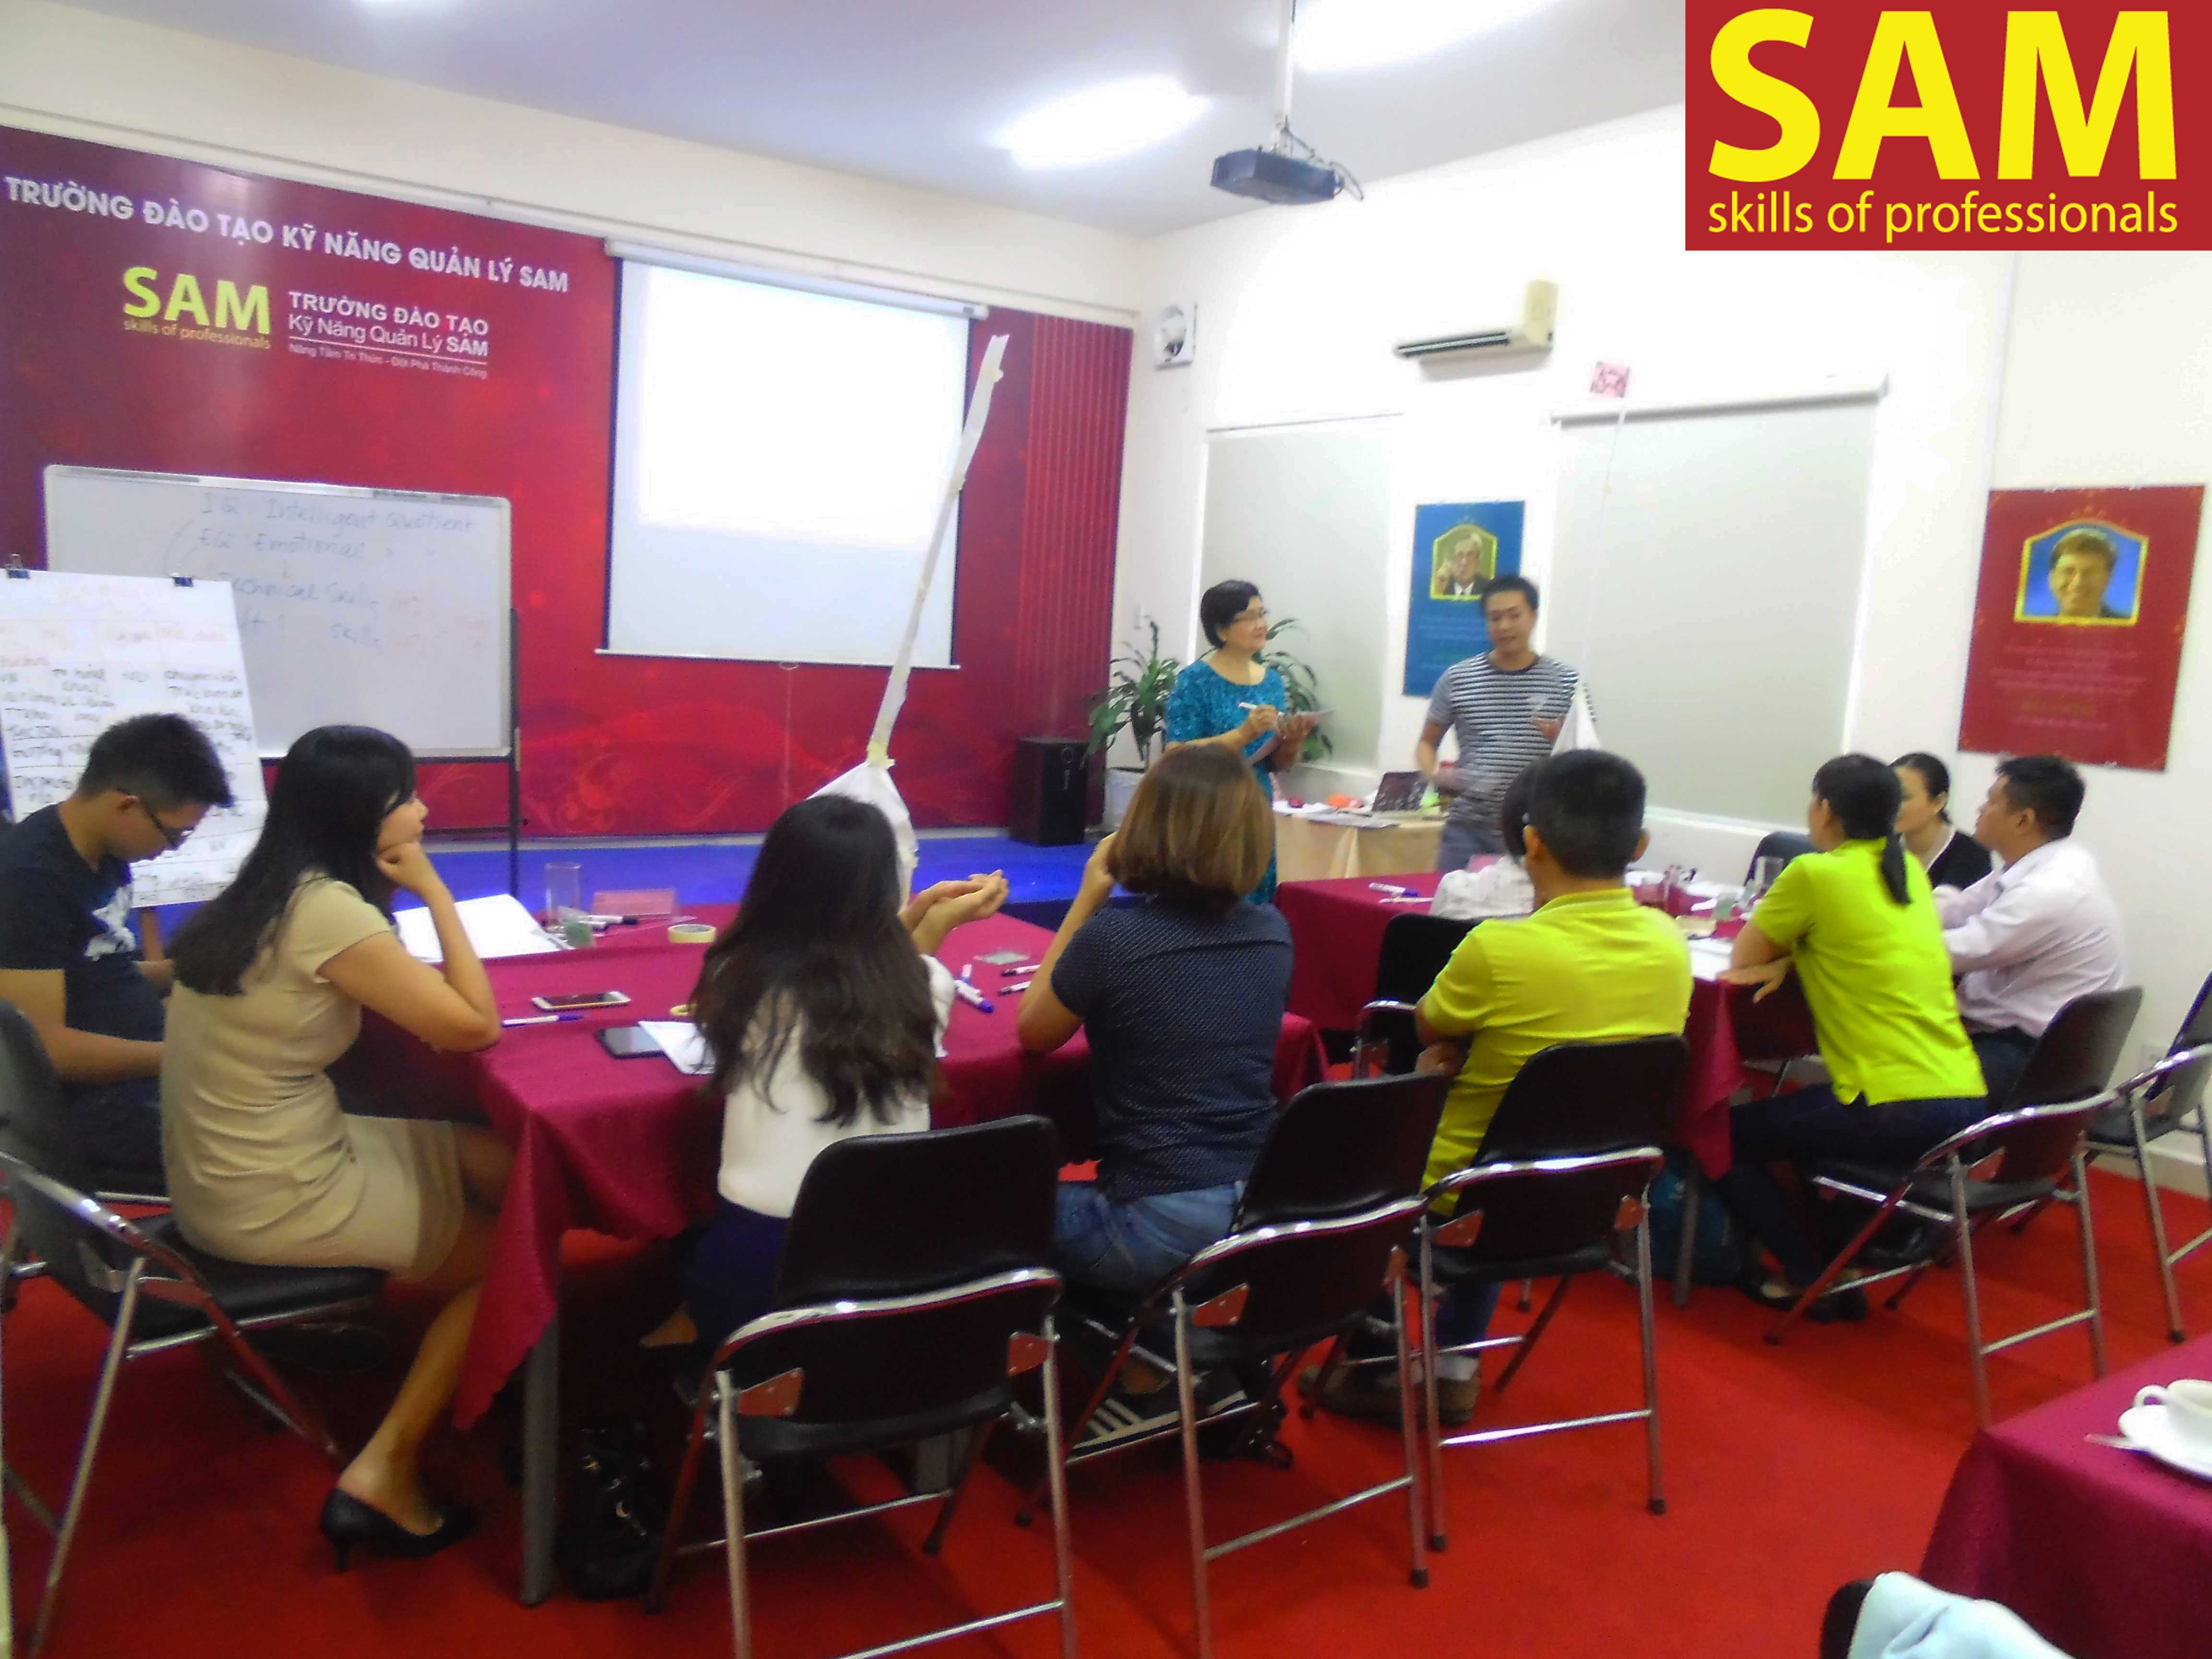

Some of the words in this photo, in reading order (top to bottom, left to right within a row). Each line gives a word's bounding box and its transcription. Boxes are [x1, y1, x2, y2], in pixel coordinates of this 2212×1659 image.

[4, 176, 135, 220] TRƯỜNG
[143, 198, 209, 232] ĐÀO
[217, 214, 273, 245] TẠO
[282, 223, 317, 251] KỸ
[324, 230, 402, 264] NĂNG
[409, 246, 480, 278] QUẢN
[488, 257, 512, 283] LÝ
[519, 265, 568, 292] SAM
[123, 266, 271, 334] SAM
[289, 291, 387, 321] TRƯỜNG
[393, 306, 440, 328] ĐÀO
[289, 313, 313, 336] Kỹ
[317, 317, 366, 344] Năng
[422, 332, 443, 354] Lý
[446, 336, 488, 356] SAM
